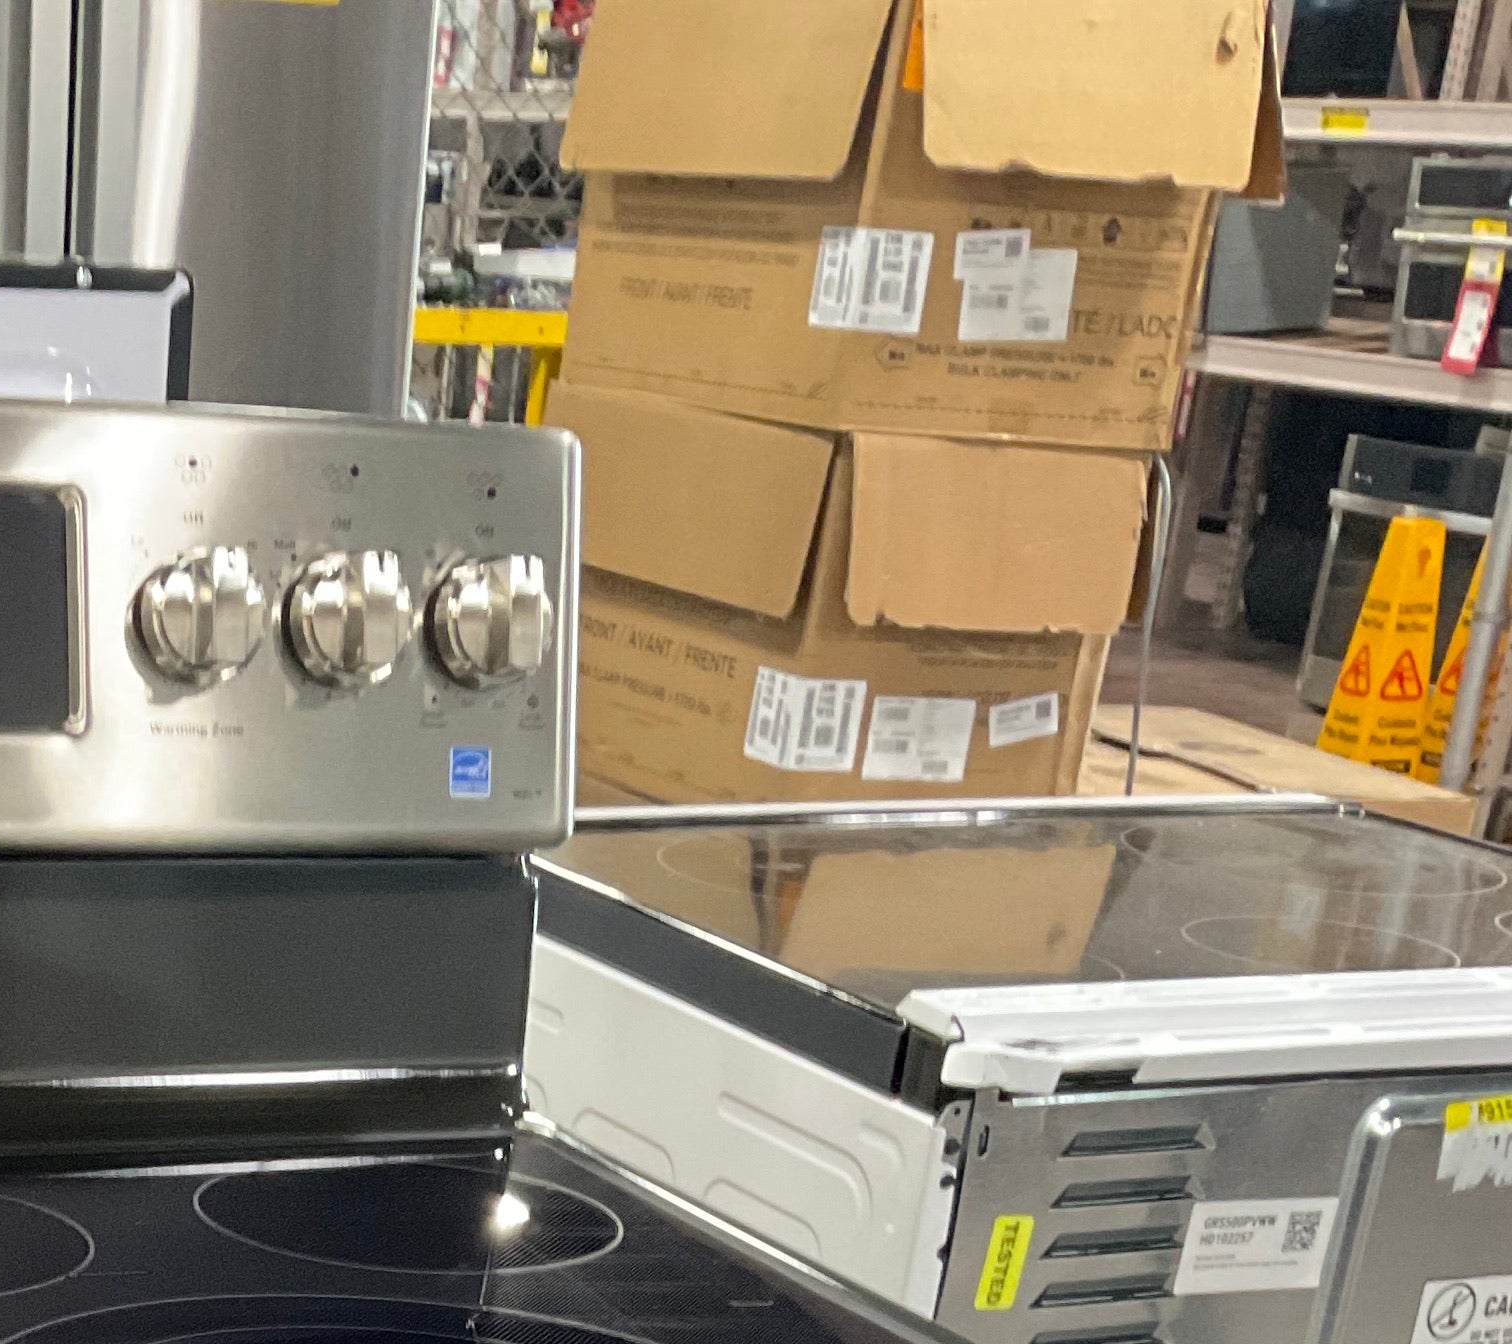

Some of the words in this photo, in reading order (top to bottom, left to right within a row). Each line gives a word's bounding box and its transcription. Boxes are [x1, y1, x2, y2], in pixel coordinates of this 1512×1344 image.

[150, 721, 207, 739] Warming
[212, 721, 244, 738] Zone
[986, 1220, 1020, 1306] TESTED
